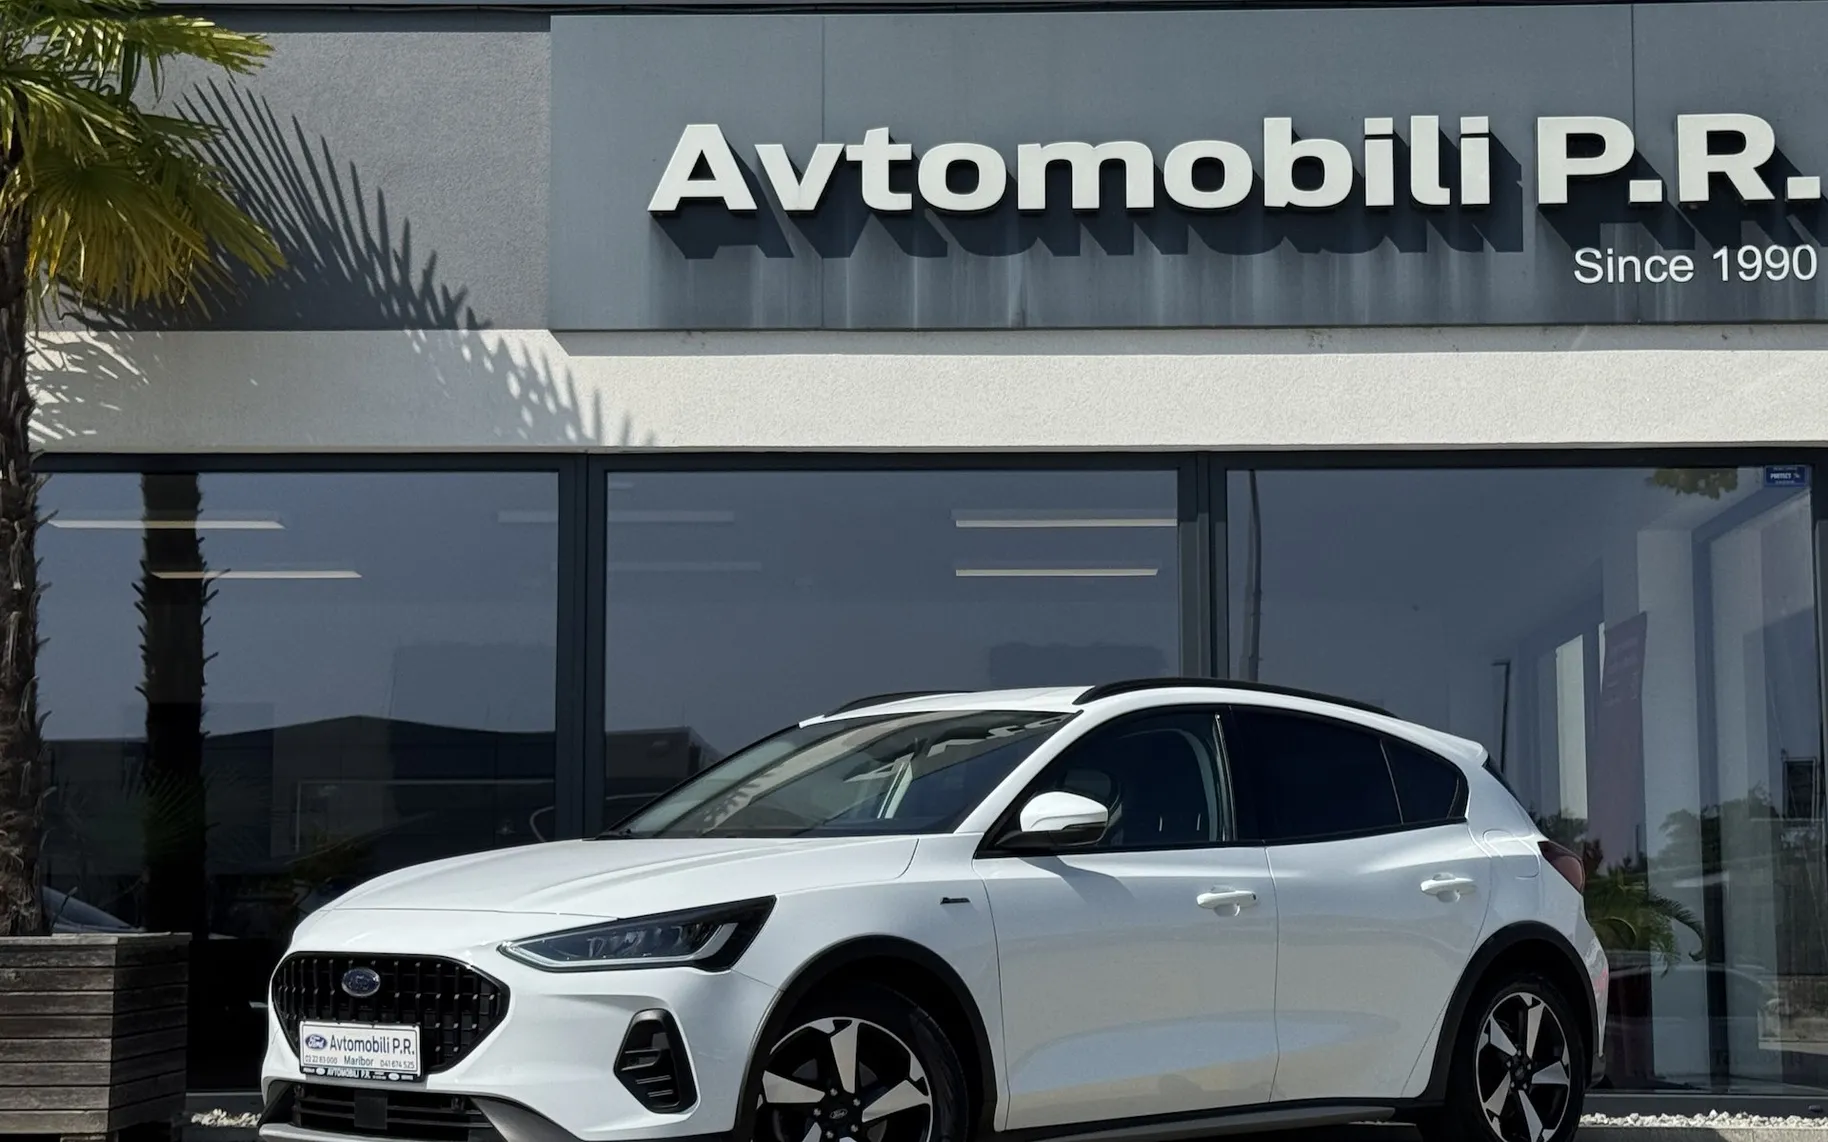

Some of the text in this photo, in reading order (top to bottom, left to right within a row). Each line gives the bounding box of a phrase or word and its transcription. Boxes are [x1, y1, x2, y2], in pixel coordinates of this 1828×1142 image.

[648, 114, 1820, 210] Avtomobili P.R.
[1575, 245, 1816, 283] Since 1990
[307, 1034, 327, 1049] Ford
[330, 1034, 415, 1056] Avtomobili P.R.
[344, 1055, 374, 1067] Maribor
